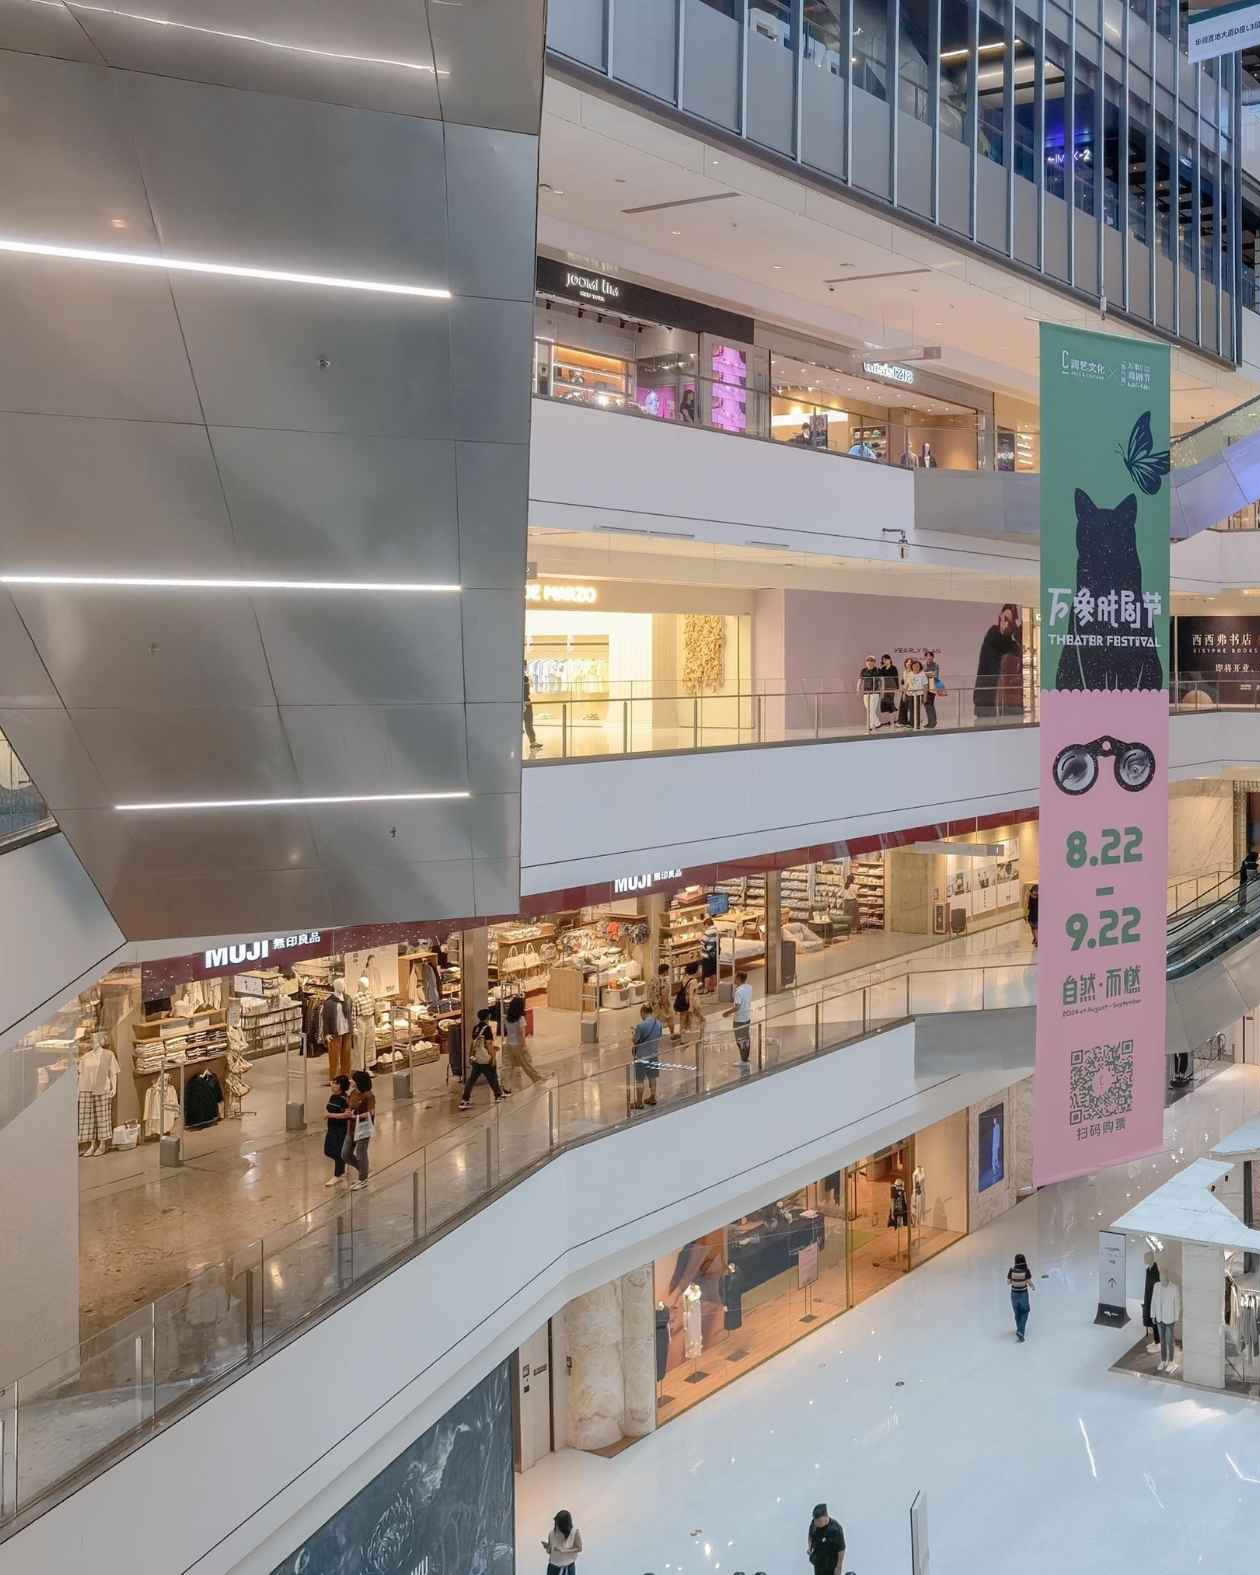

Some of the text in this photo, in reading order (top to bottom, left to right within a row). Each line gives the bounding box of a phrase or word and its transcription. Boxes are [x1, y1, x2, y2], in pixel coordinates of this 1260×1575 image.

[1047, 634, 1162, 648] THEATER FESTIVAL
[1192, 632, 1252, 647] 西西弗书店
[1065, 826, 1144, 868] 8.22
[614, 873, 653, 894] MUJI
[1065, 906, 1142, 952] 9.22
[205, 931, 321, 969] MUJI 無印良品
